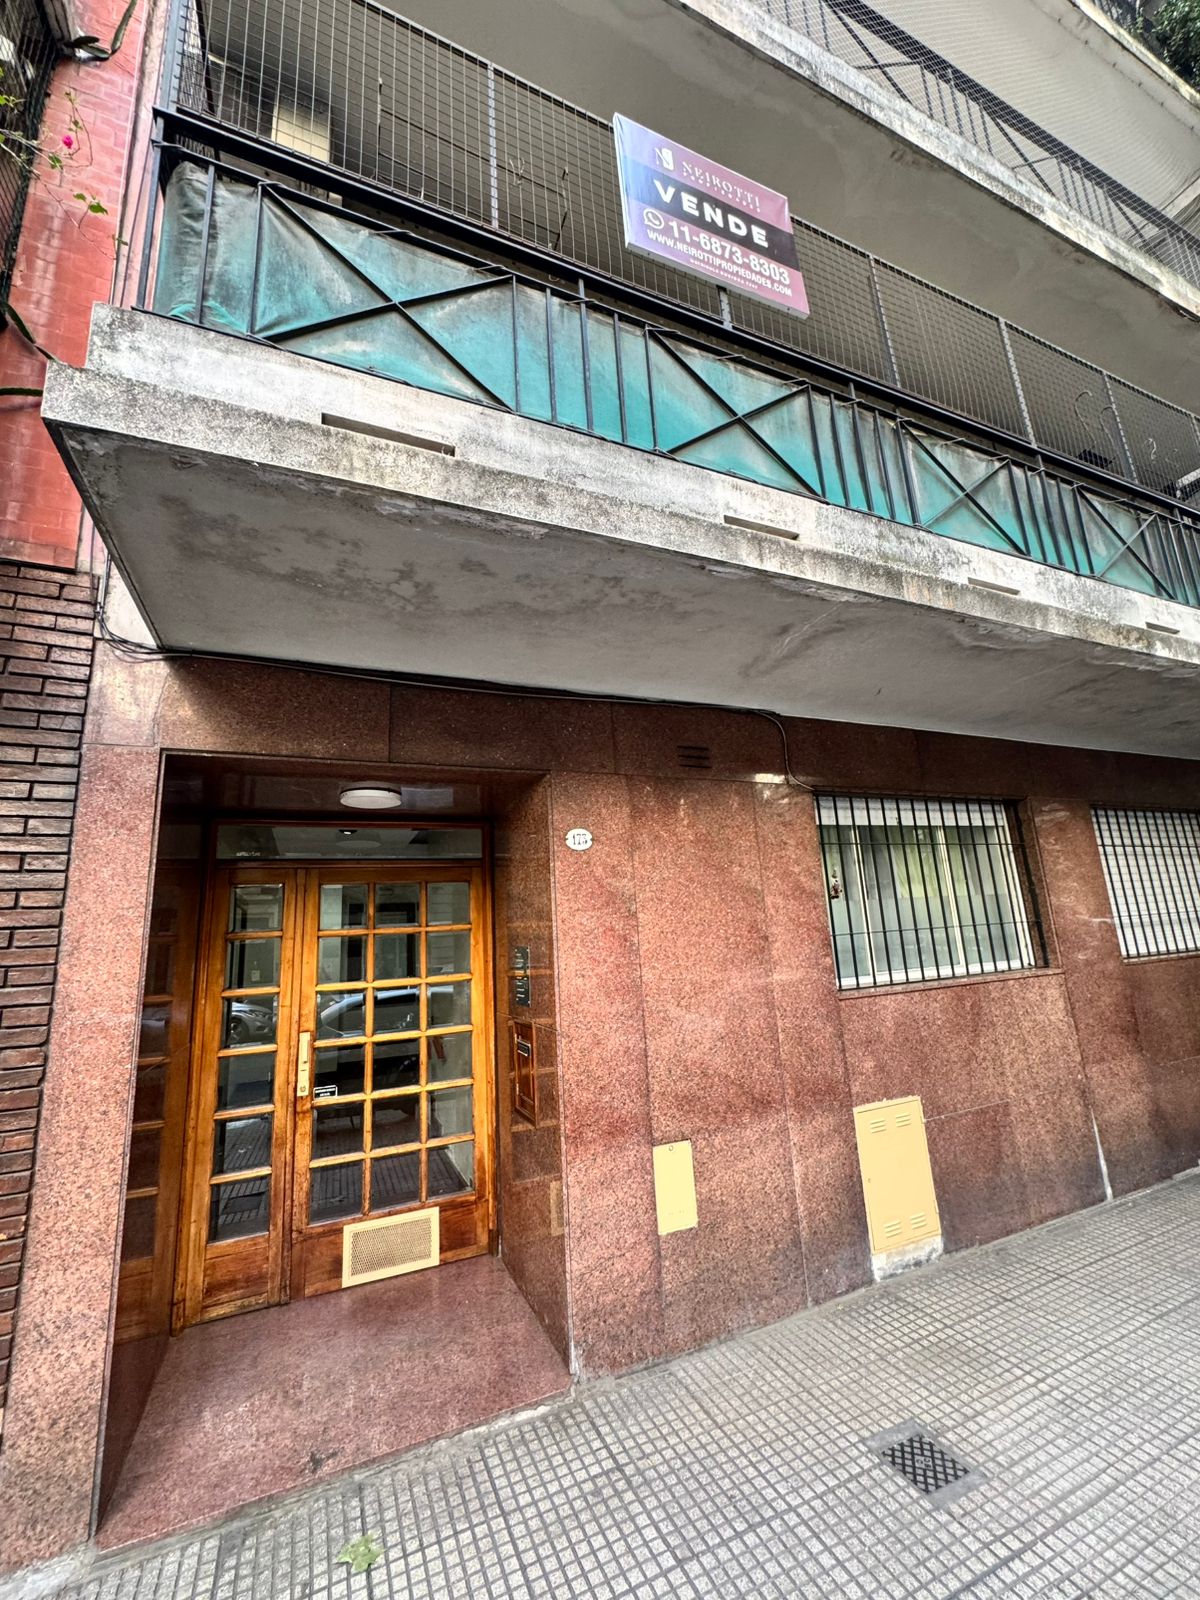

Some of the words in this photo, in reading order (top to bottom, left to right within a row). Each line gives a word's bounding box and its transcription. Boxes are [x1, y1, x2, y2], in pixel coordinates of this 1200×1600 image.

[653, 179, 769, 249] VENDE
[682, 161, 760, 207] NEIROTTI
[646, 229, 793, 297] WWW.NEIROTTIPROPIEDADES.COM
[669, 220, 790, 285] 11-6873-8303
